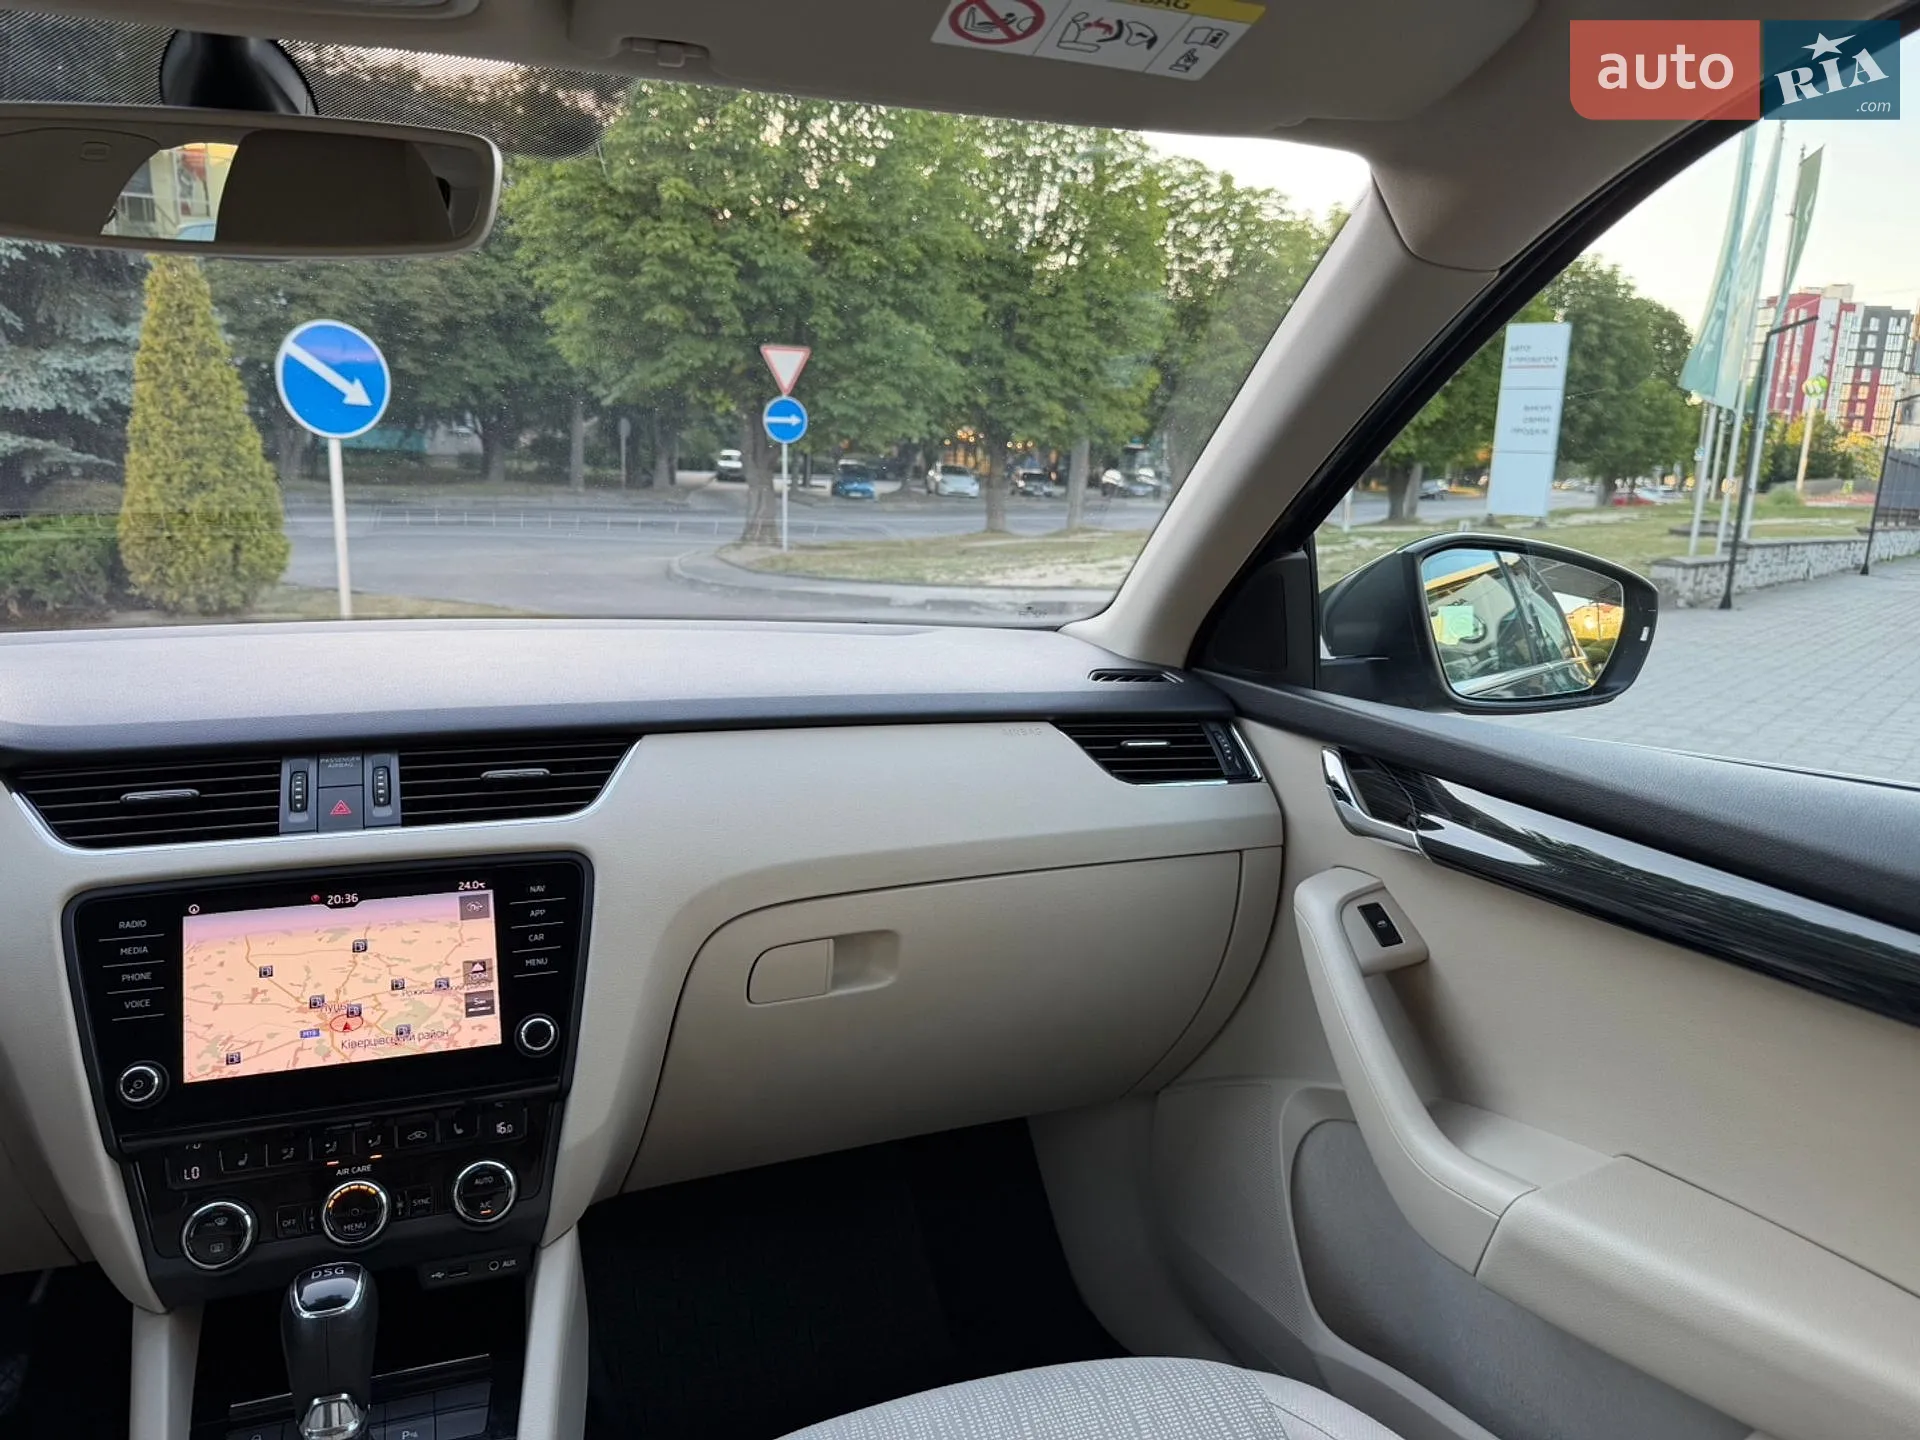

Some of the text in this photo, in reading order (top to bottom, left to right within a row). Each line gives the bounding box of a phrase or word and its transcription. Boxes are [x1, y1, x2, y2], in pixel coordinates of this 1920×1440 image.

[529, 885, 546, 893] NAV
[326, 893, 359, 906] 20:36
[529, 909, 546, 917] APP
[118, 919, 147, 929] RADIO
[528, 933, 545, 942] CAR
[119, 945, 149, 956] MEDIA
[525, 957, 548, 966] MENU
[121, 971, 152, 982] PHONE
[124, 998, 151, 1009] VOICE
[418, 1029, 449, 1042] район
[336, 1164, 373, 1177] AIR CARE
[474, 1176, 494, 1186] AUTO
[343, 1221, 367, 1232] MENU
[502, 1259, 517, 1268] AUX
[311, 1267, 345, 1280] DSG
